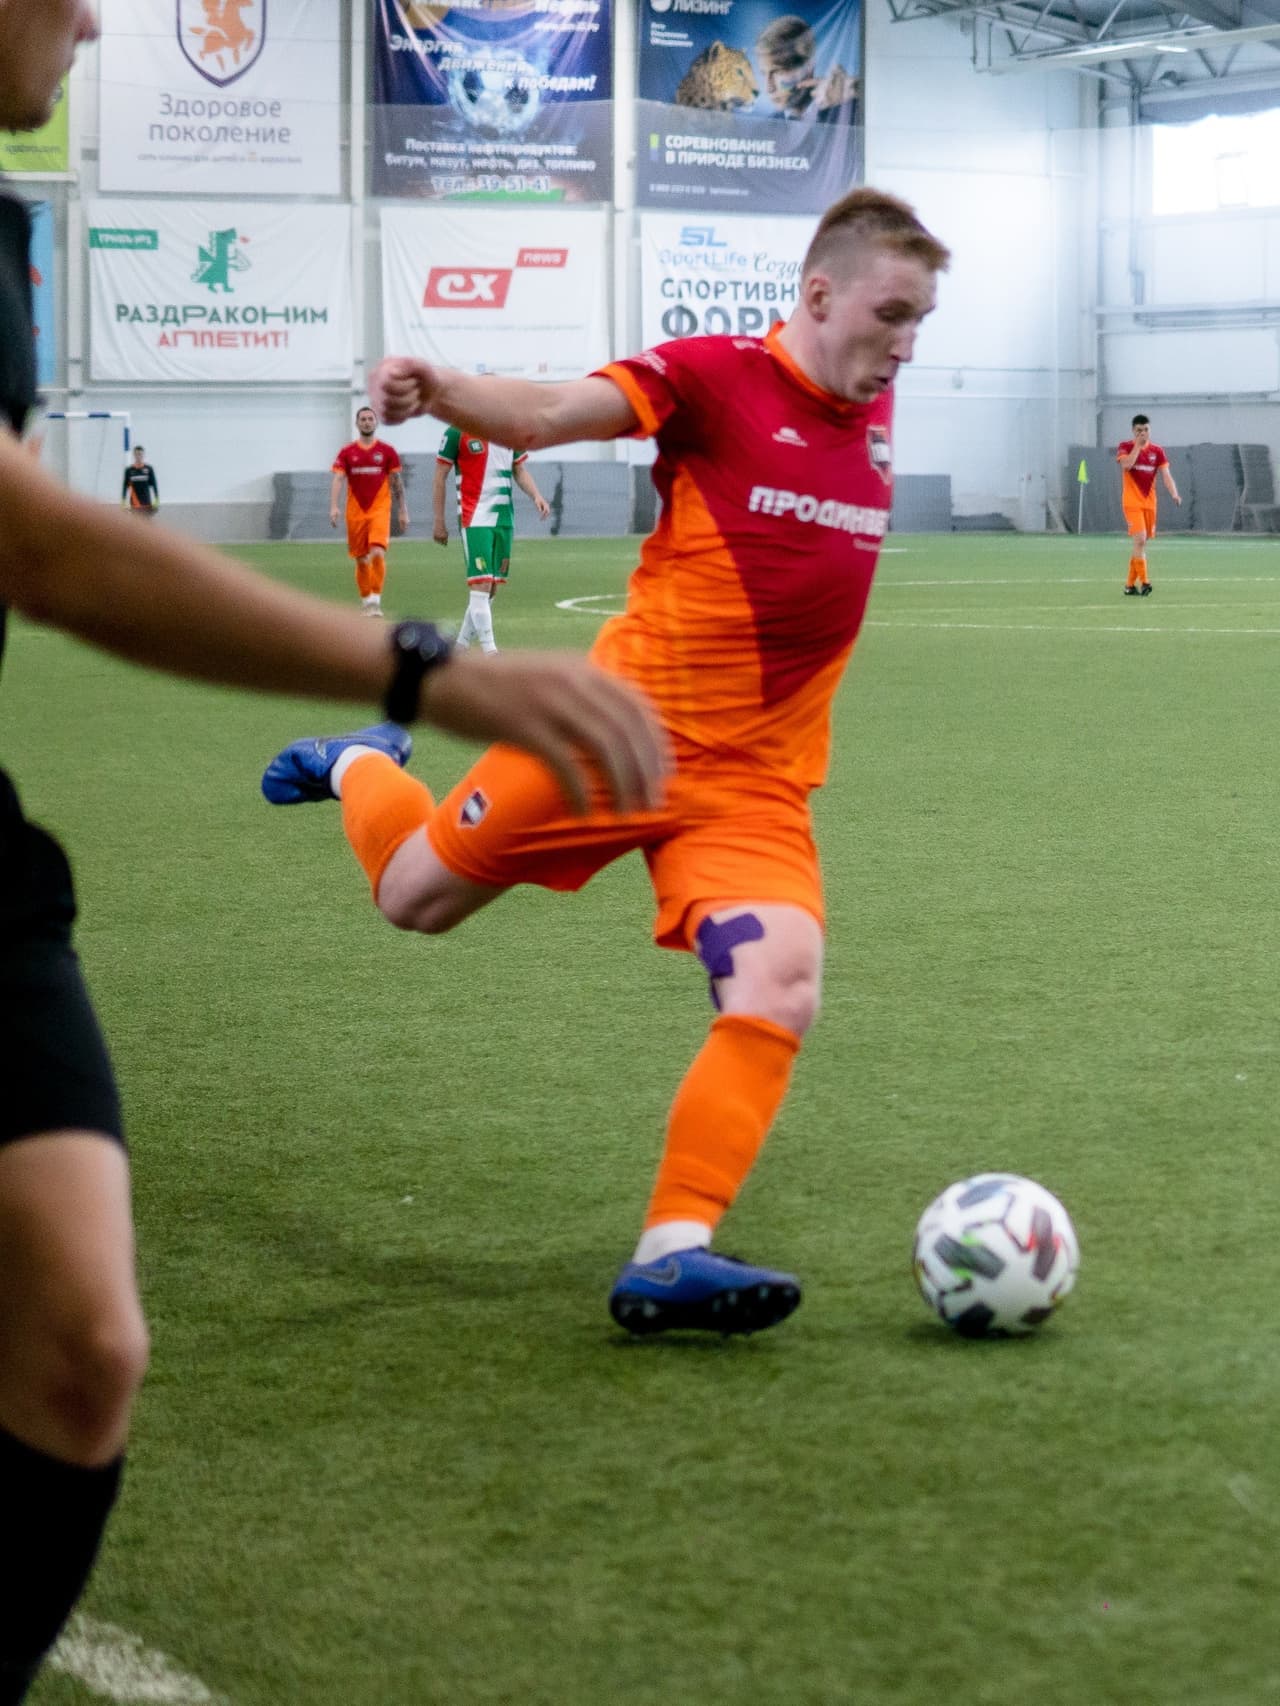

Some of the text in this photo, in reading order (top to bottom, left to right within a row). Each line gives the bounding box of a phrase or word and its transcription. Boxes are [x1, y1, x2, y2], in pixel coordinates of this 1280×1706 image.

[159, 93, 282, 119] Здоровое
[148, 122, 291, 145] поколение
[665, 134, 776, 154] СОРЕВНОВАНИЕ
[665, 150, 810, 172] В ПРИРОДЕ БИЗНЕСА
[680, 225, 728, 248] SL
[660, 277, 801, 303] СПОРТИВН
[115, 303, 329, 328] РАЗДРАКОНИМ
[158, 330, 289, 349] АППЕТИТ!
